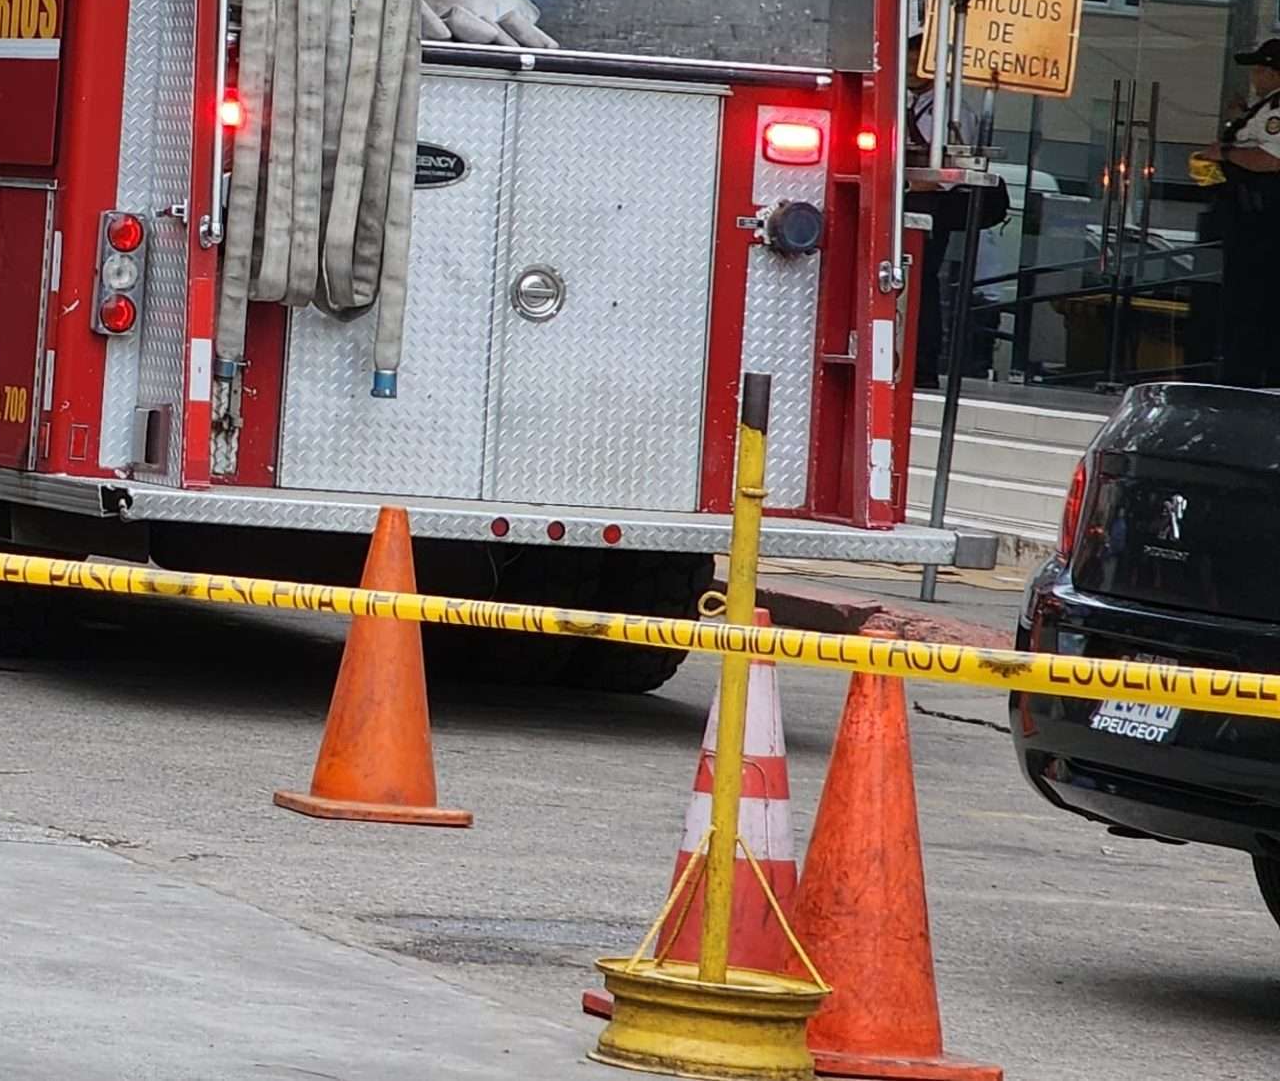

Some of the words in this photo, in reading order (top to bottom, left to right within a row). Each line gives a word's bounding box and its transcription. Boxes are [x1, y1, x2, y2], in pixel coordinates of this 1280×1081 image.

[988, 21, 1015, 44] DE
[962, 46, 1060, 80] ERGENCIA
[3, 386, 27, 423] 708
[1099, 716, 1169, 742] PEUGEOT
